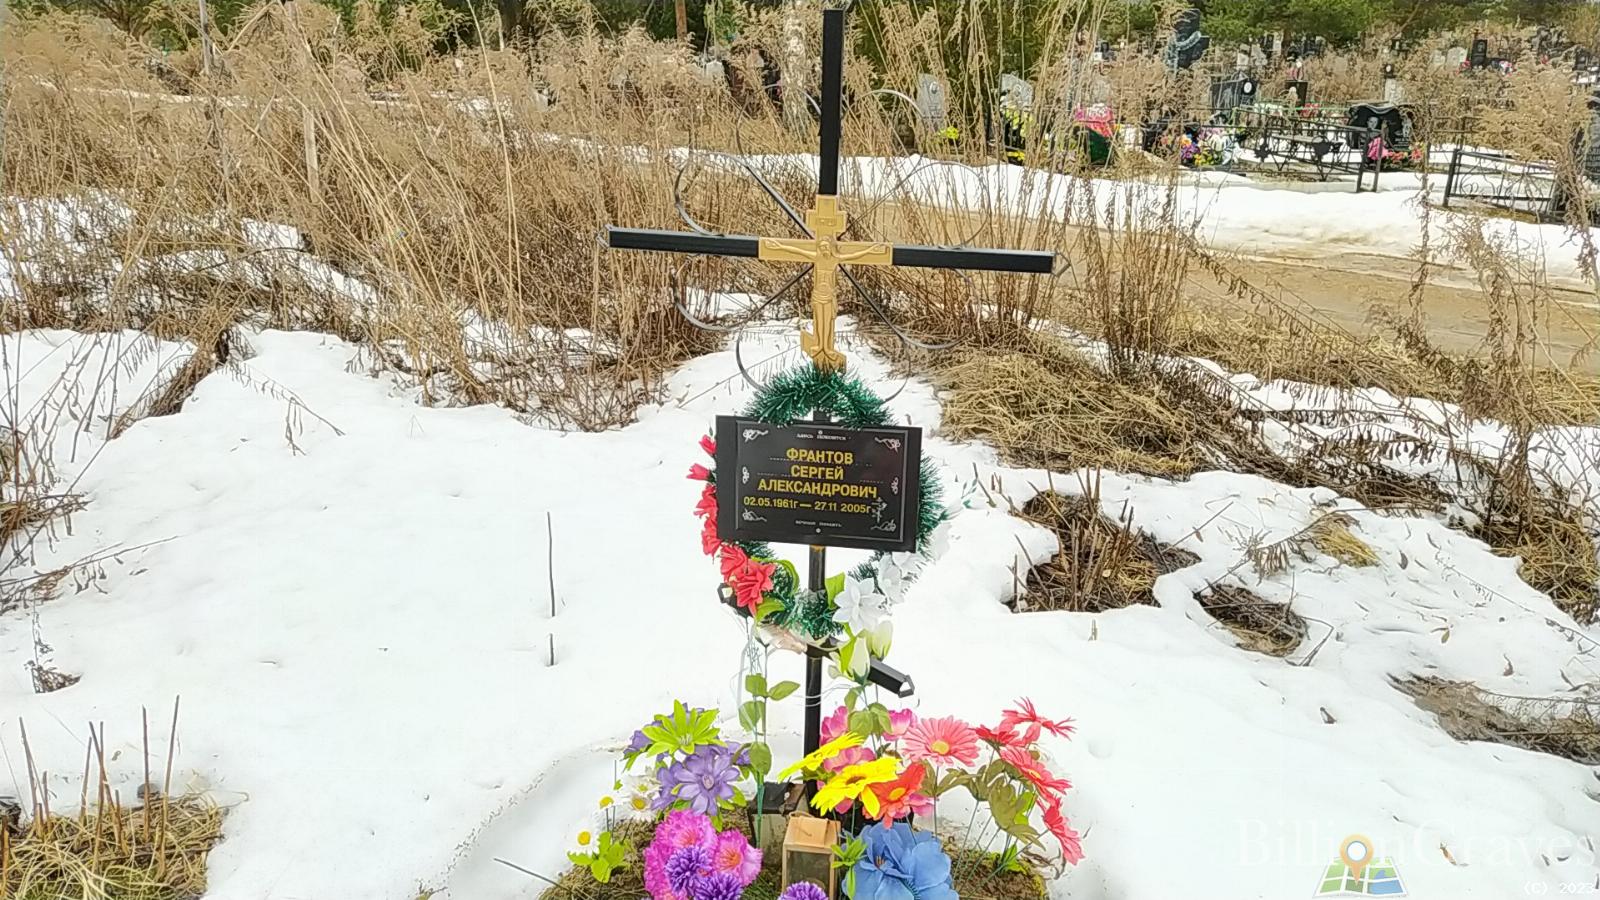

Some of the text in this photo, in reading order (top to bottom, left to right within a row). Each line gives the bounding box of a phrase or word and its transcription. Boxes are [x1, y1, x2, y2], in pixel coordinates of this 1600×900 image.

[786, 447, 854, 465] ФРАНТОВ
[790, 465, 844, 480] СЕРГЕЙ
[757, 478, 878, 498] АЛЕКСАНДРОВИЧ
